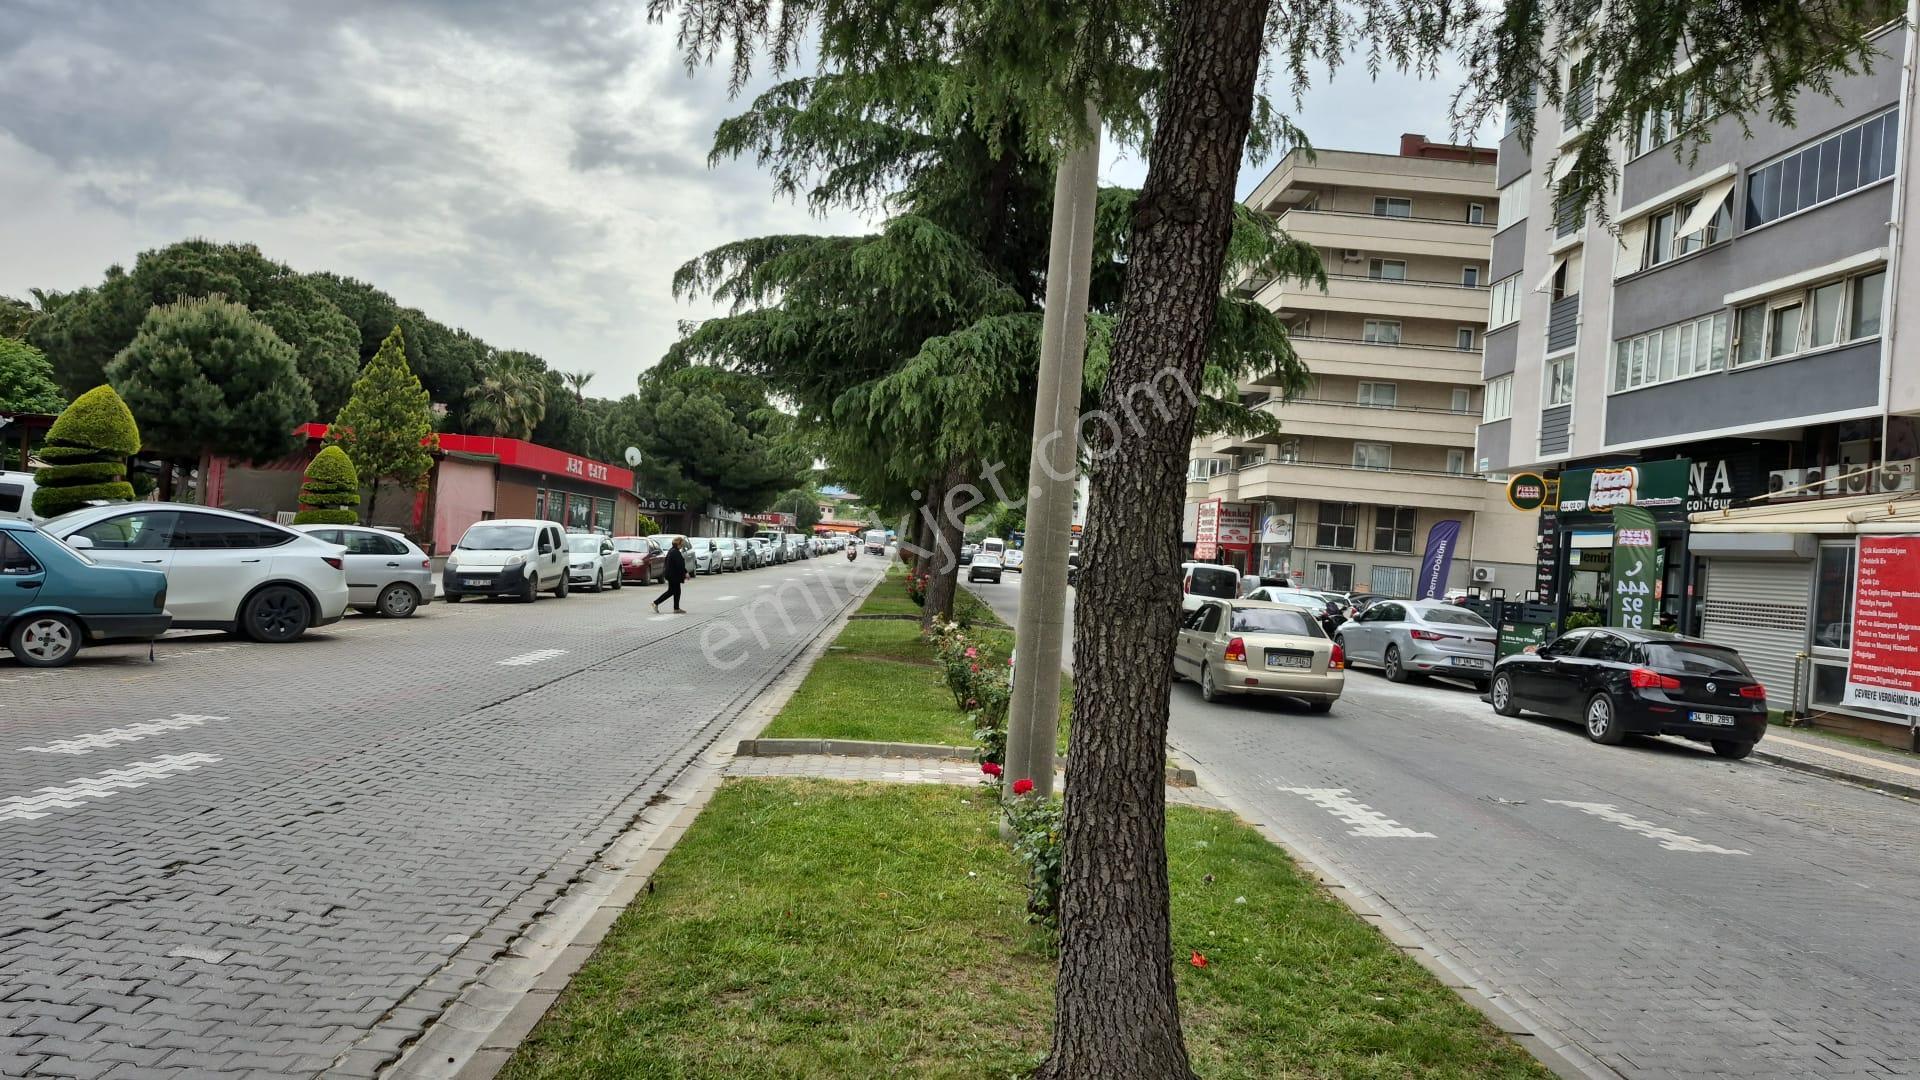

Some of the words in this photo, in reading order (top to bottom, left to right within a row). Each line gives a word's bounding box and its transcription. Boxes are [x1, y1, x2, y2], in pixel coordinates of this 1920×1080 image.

[1687, 497, 1731, 510] coiffeur
[1427, 540, 1447, 597] DemirDöküm
[1855, 688, 1877, 700] ÇEVREYE
[1879, 690, 1909, 705] VERDİĞİMİZ
[1693, 712, 1701, 721] 34
